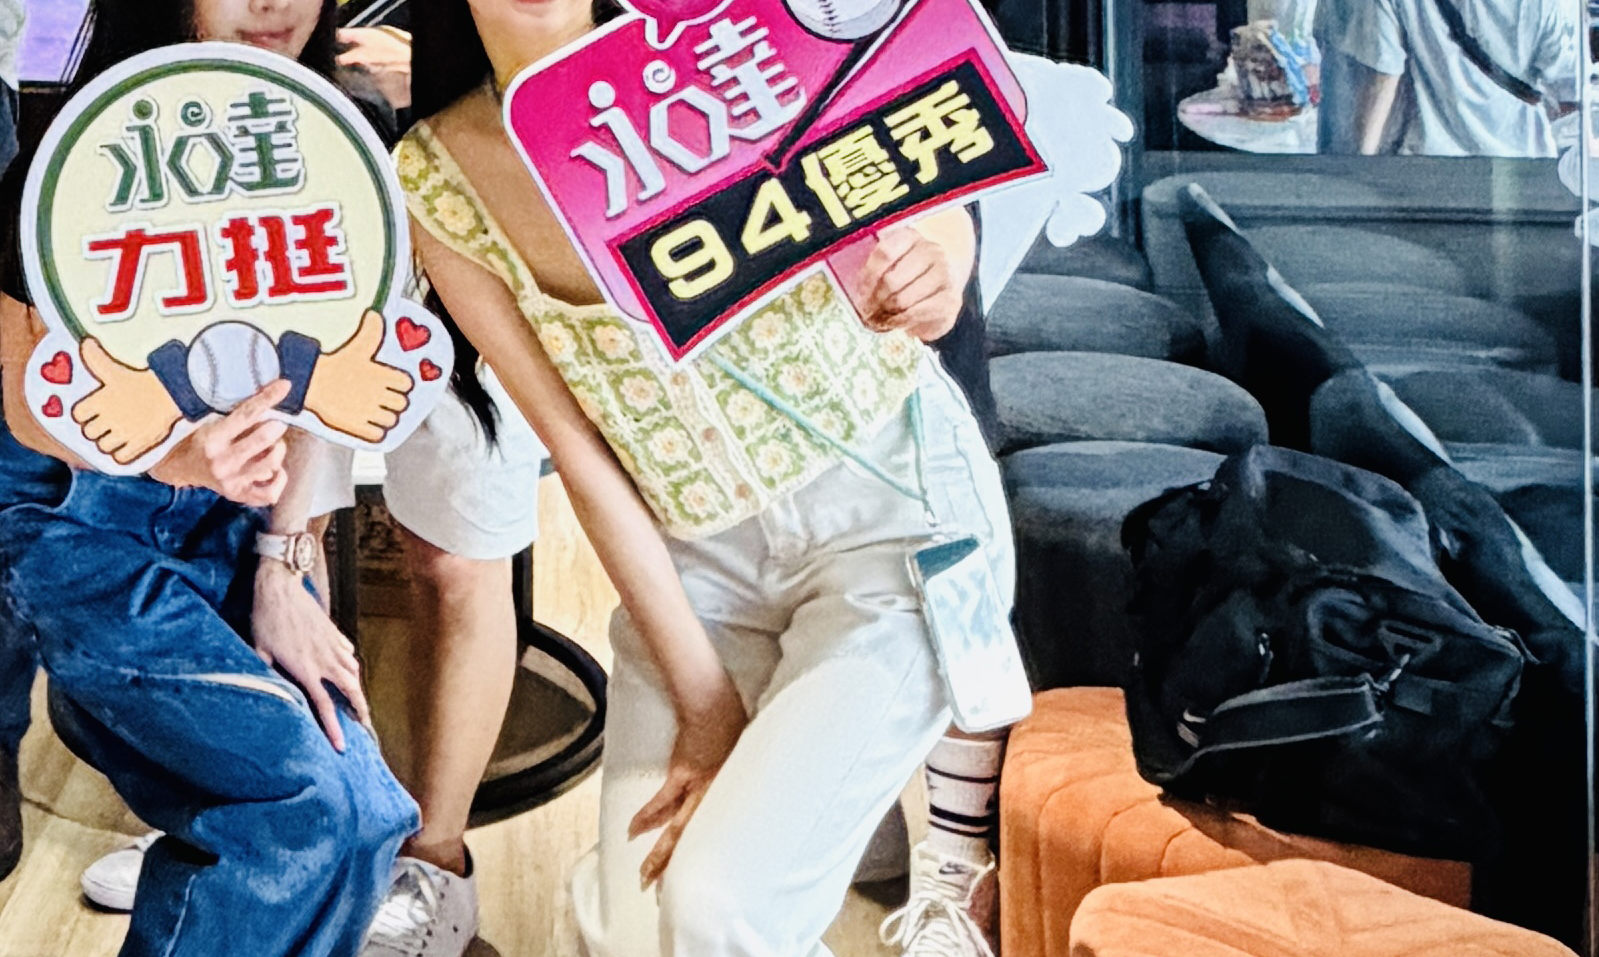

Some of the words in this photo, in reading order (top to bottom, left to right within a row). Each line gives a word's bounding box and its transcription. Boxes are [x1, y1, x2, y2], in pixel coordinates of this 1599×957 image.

[99, 90, 304, 208] 永達
[569, 15, 807, 220] 永達
[650, 79, 996, 301] 94優秀
[88, 207, 349, 316] 力挺
